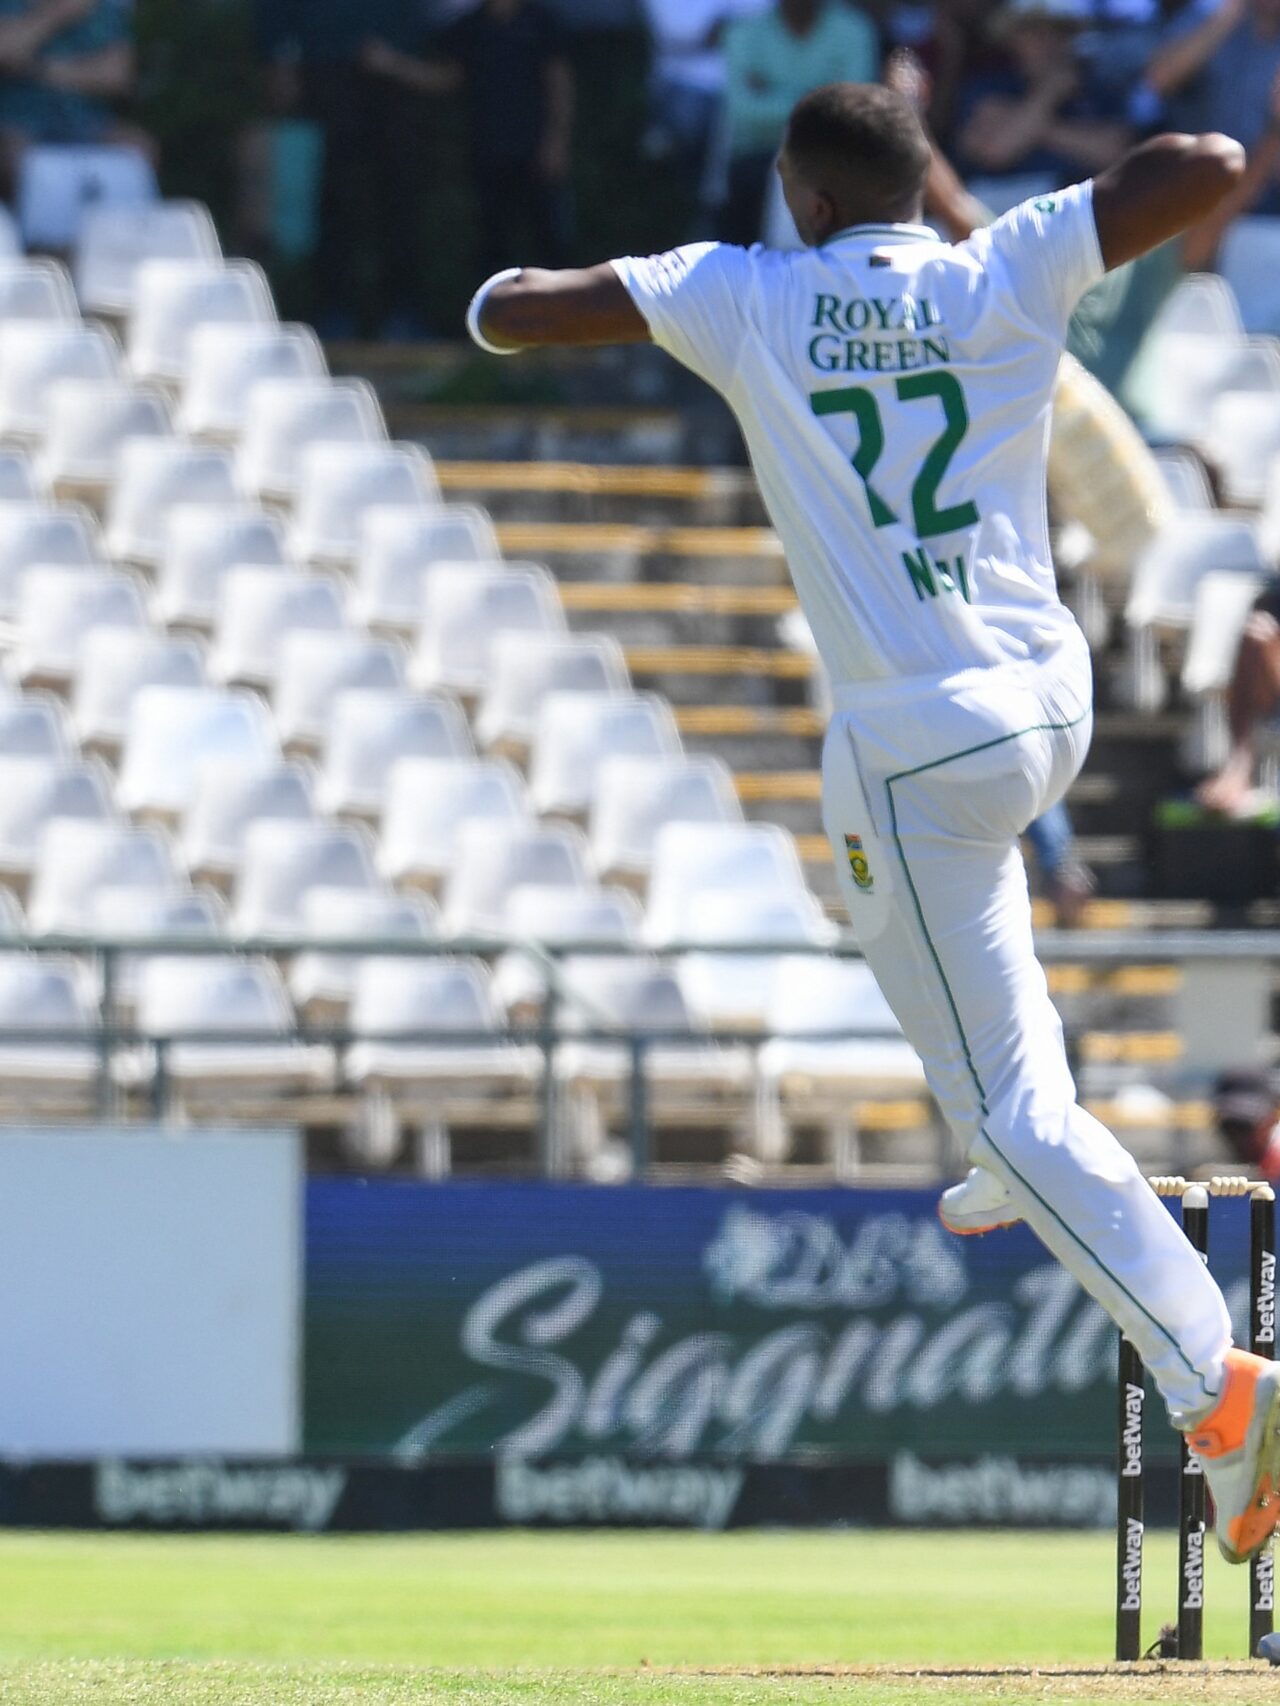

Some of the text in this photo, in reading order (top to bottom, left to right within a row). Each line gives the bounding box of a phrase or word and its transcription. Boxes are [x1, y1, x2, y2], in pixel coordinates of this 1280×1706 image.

[808, 335, 950, 372] GREEN
[810, 293, 945, 335] ROYAL
[810, 370, 981, 538] 22
[1255, 1250, 1277, 1343] betway
[1122, 1382, 1145, 1477] betway
[1121, 1517, 1144, 1611] betway
